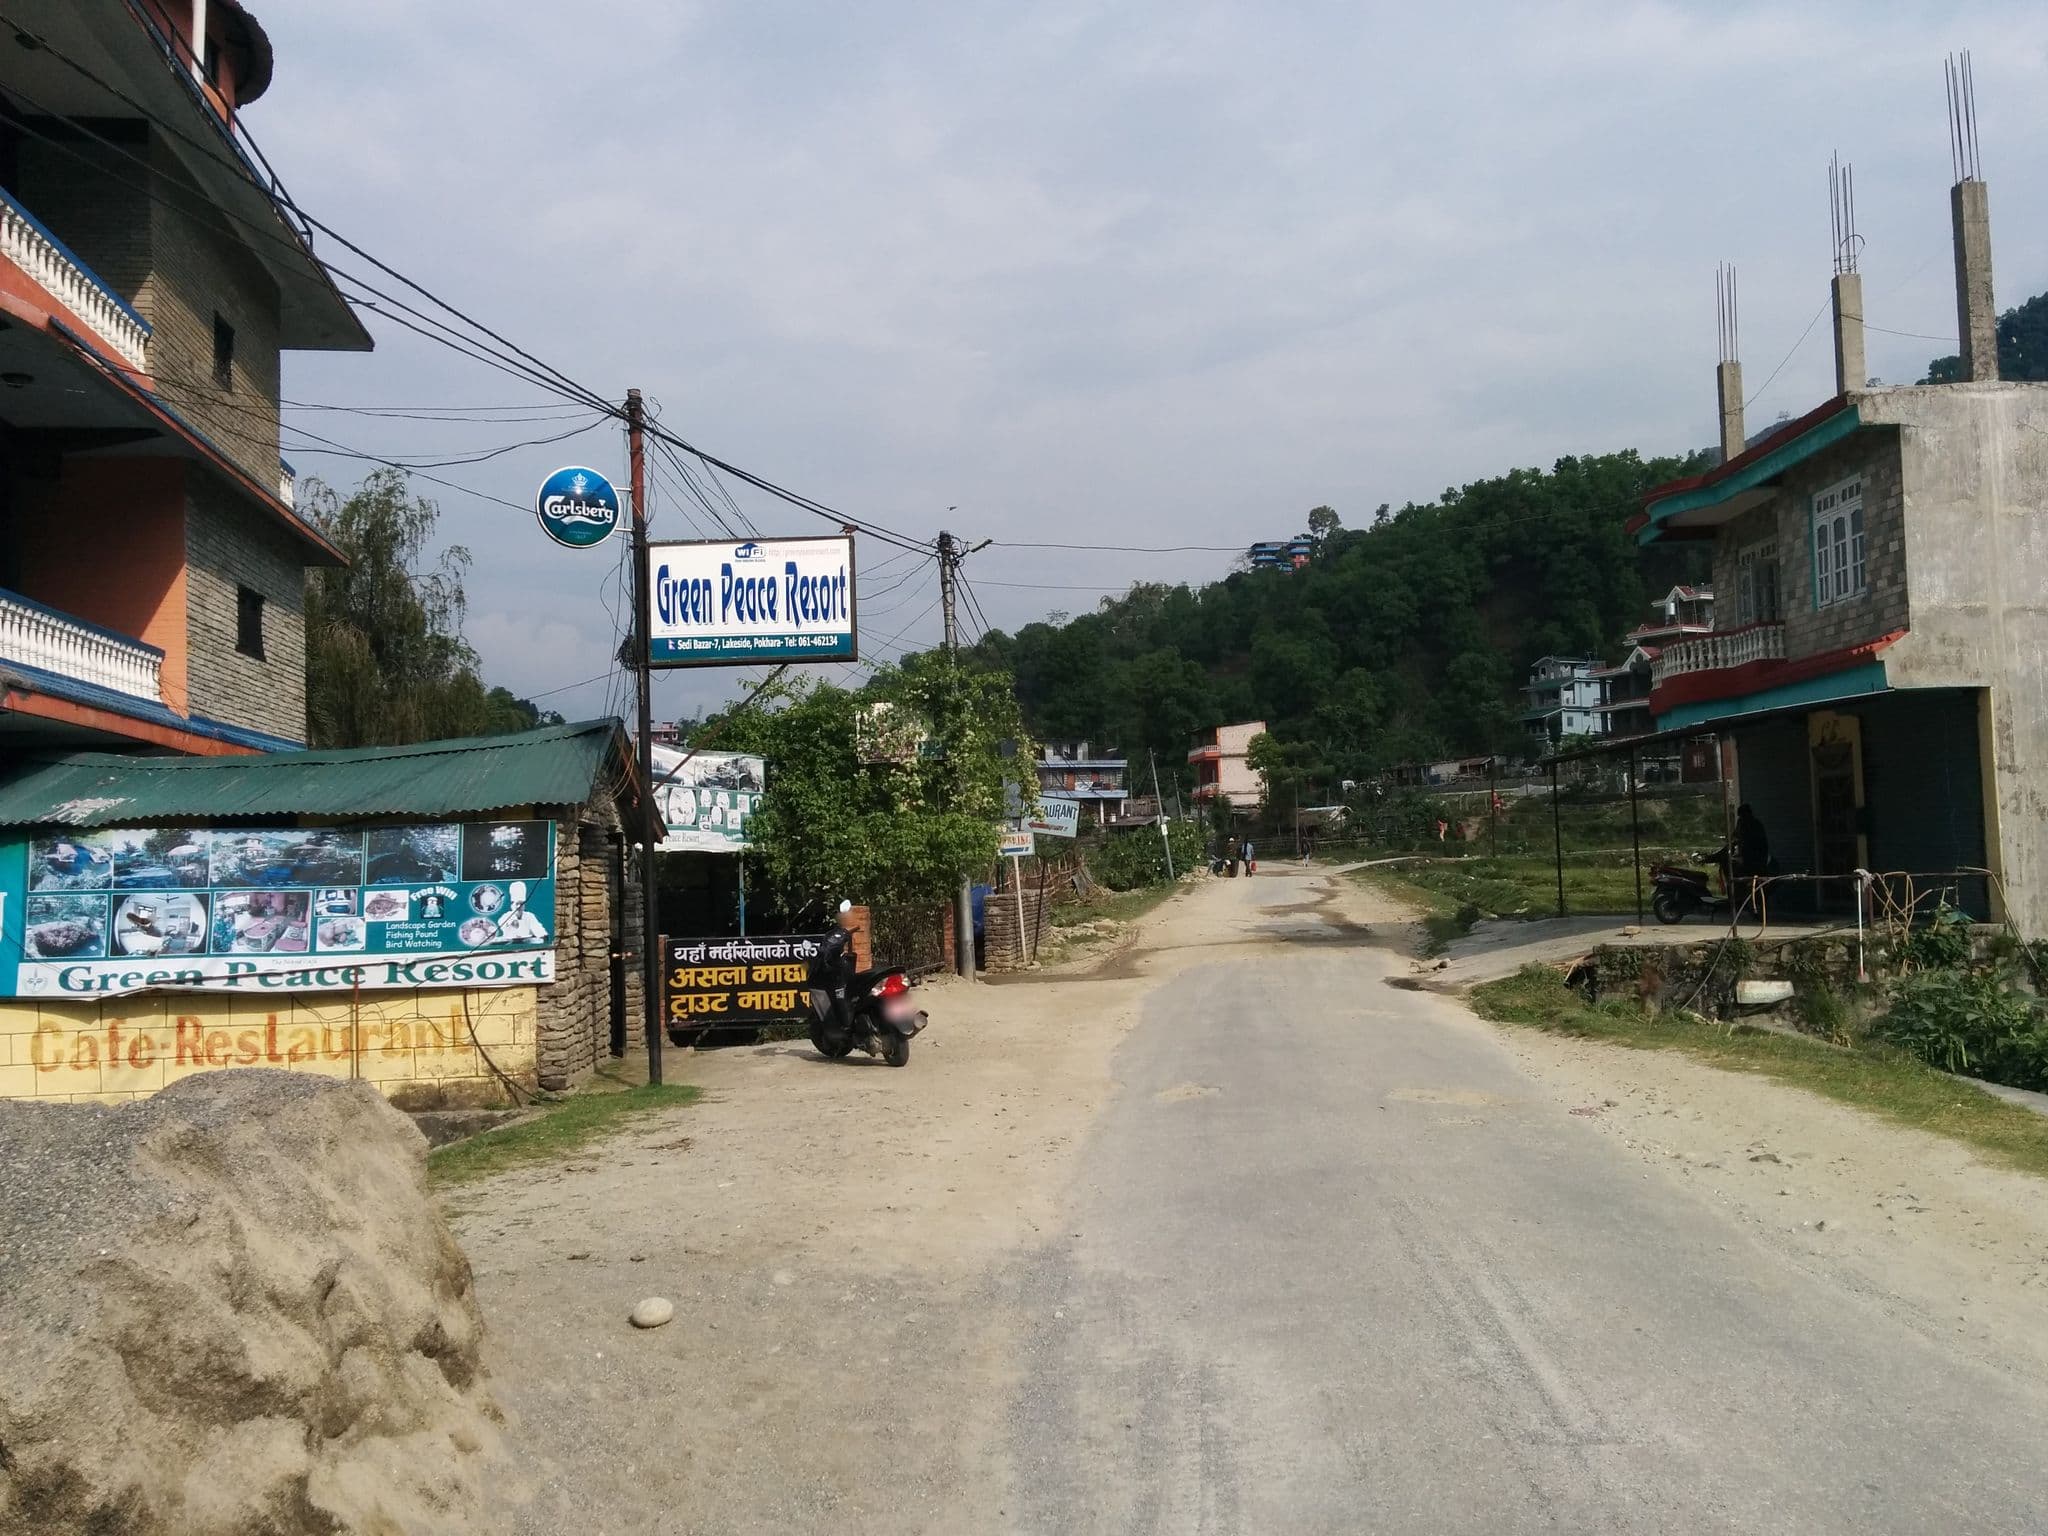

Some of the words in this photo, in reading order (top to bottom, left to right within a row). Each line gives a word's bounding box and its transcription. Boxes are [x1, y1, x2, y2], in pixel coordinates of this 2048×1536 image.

[544, 495, 614, 525] Carlsberg
[657, 564, 714, 625] Green
[721, 562, 780, 624] Peace
[785, 561, 848, 629] Resort
[677, 639, 692, 650] Sedi
[693, 638, 721, 651] Bazar-7,
[722, 637, 752, 650] Lakeside,
[754, 637, 784, 649] Pokhara-
[785, 636, 798, 647] Tel:
[798, 635, 838, 647] 061-462134
[410, 888, 434, 900] Free
[435, 886, 458, 900] Will
[385, 931, 414, 940] Fishing
[415, 930, 438, 938] Pound
[386, 922, 425, 931] Landscape
[386, 940, 403, 948] Bird
[405, 940, 442, 948] Watching
[674, 942, 706, 964] यहाँ
[58, 965, 203, 992] Green
[225, 961, 366, 988] Peace
[384, 955, 549, 984] Resort
[668, 966, 747, 989] असला
[670, 992, 730, 1020] ट्राउट
[737, 989, 798, 1012] माछा
